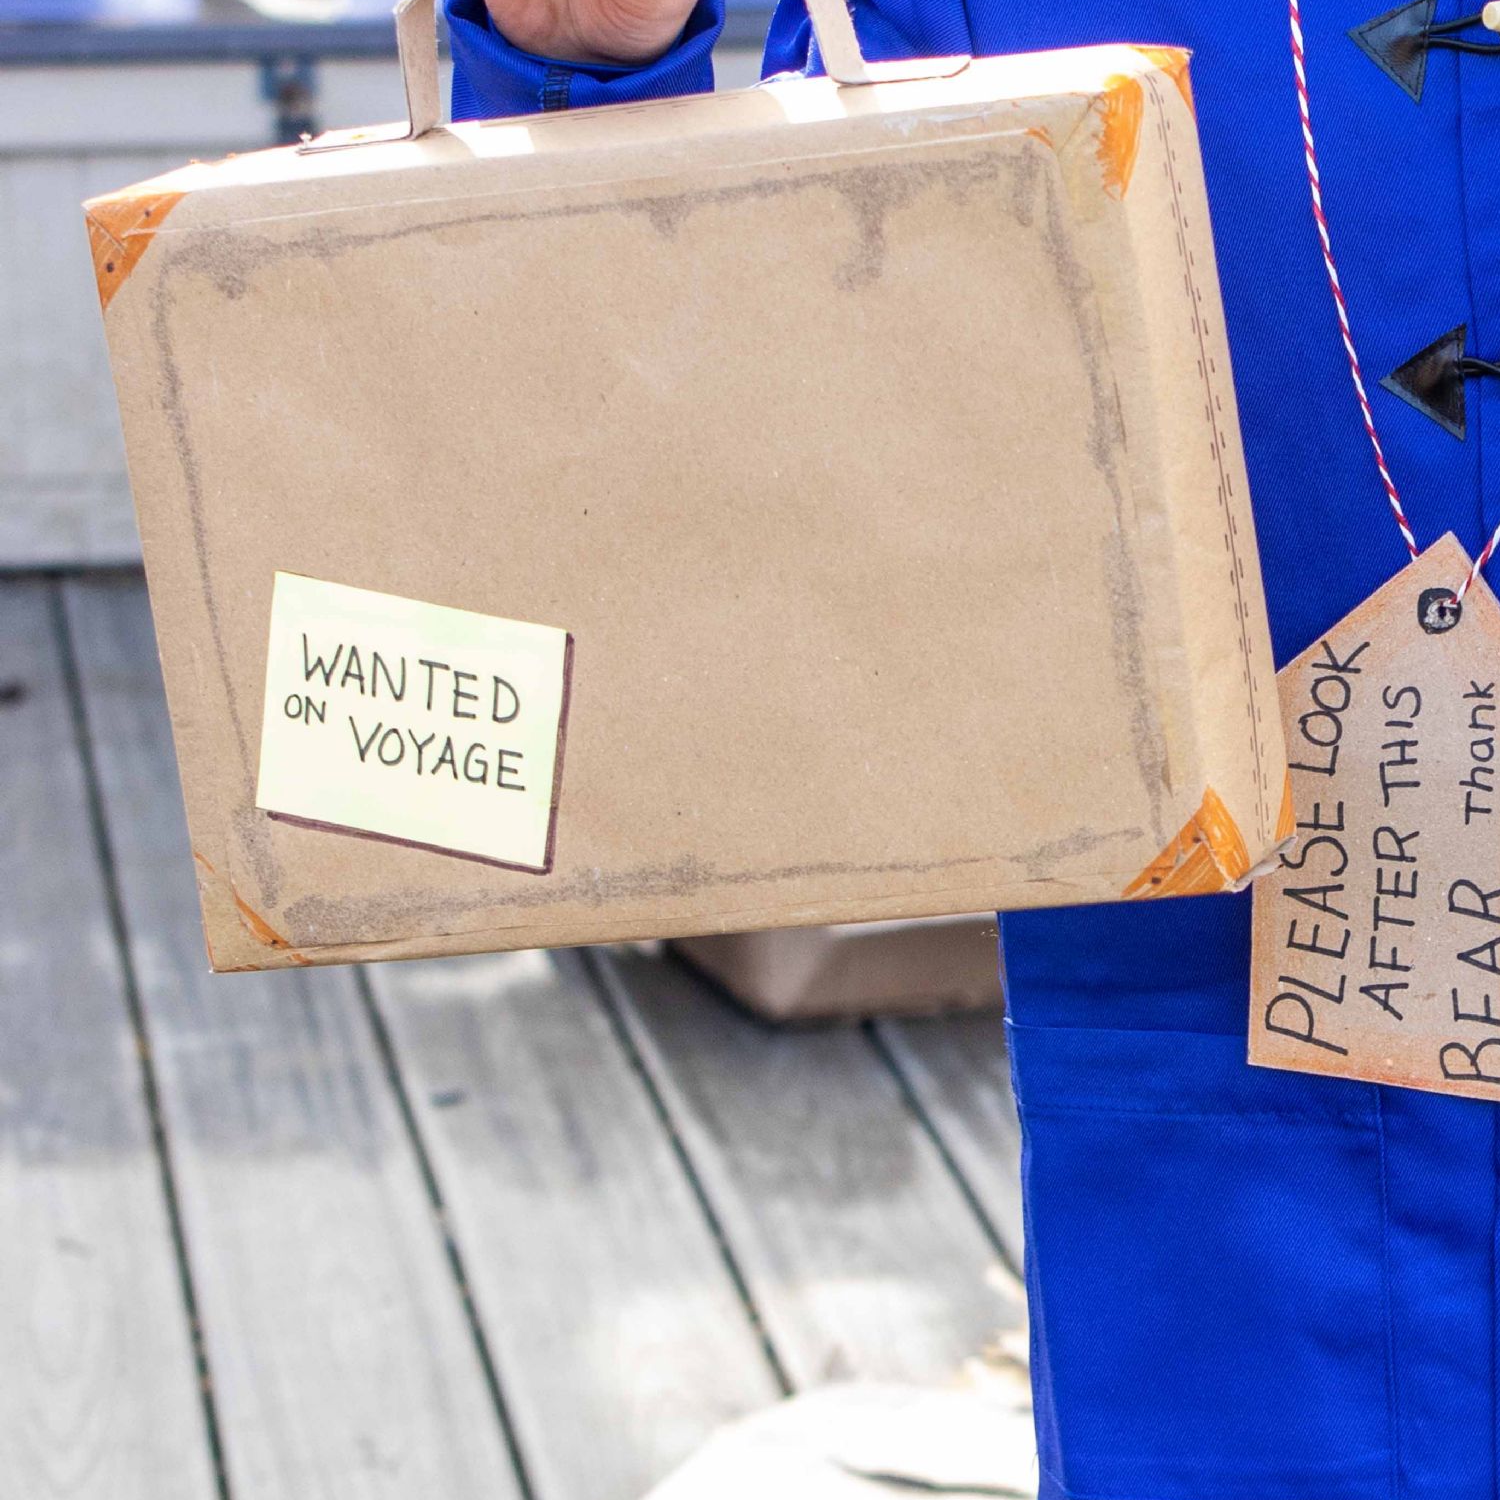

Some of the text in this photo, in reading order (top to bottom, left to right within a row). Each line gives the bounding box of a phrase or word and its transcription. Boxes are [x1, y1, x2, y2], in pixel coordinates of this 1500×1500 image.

[283, 693, 526, 792] ON VOYAGE
[301, 632, 521, 724] WANTED
[1459, 680, 1496, 825] Thank
[1265, 640, 1370, 1056] PLEASE LOOK
[1359, 685, 1422, 1021] AFTER THIS
